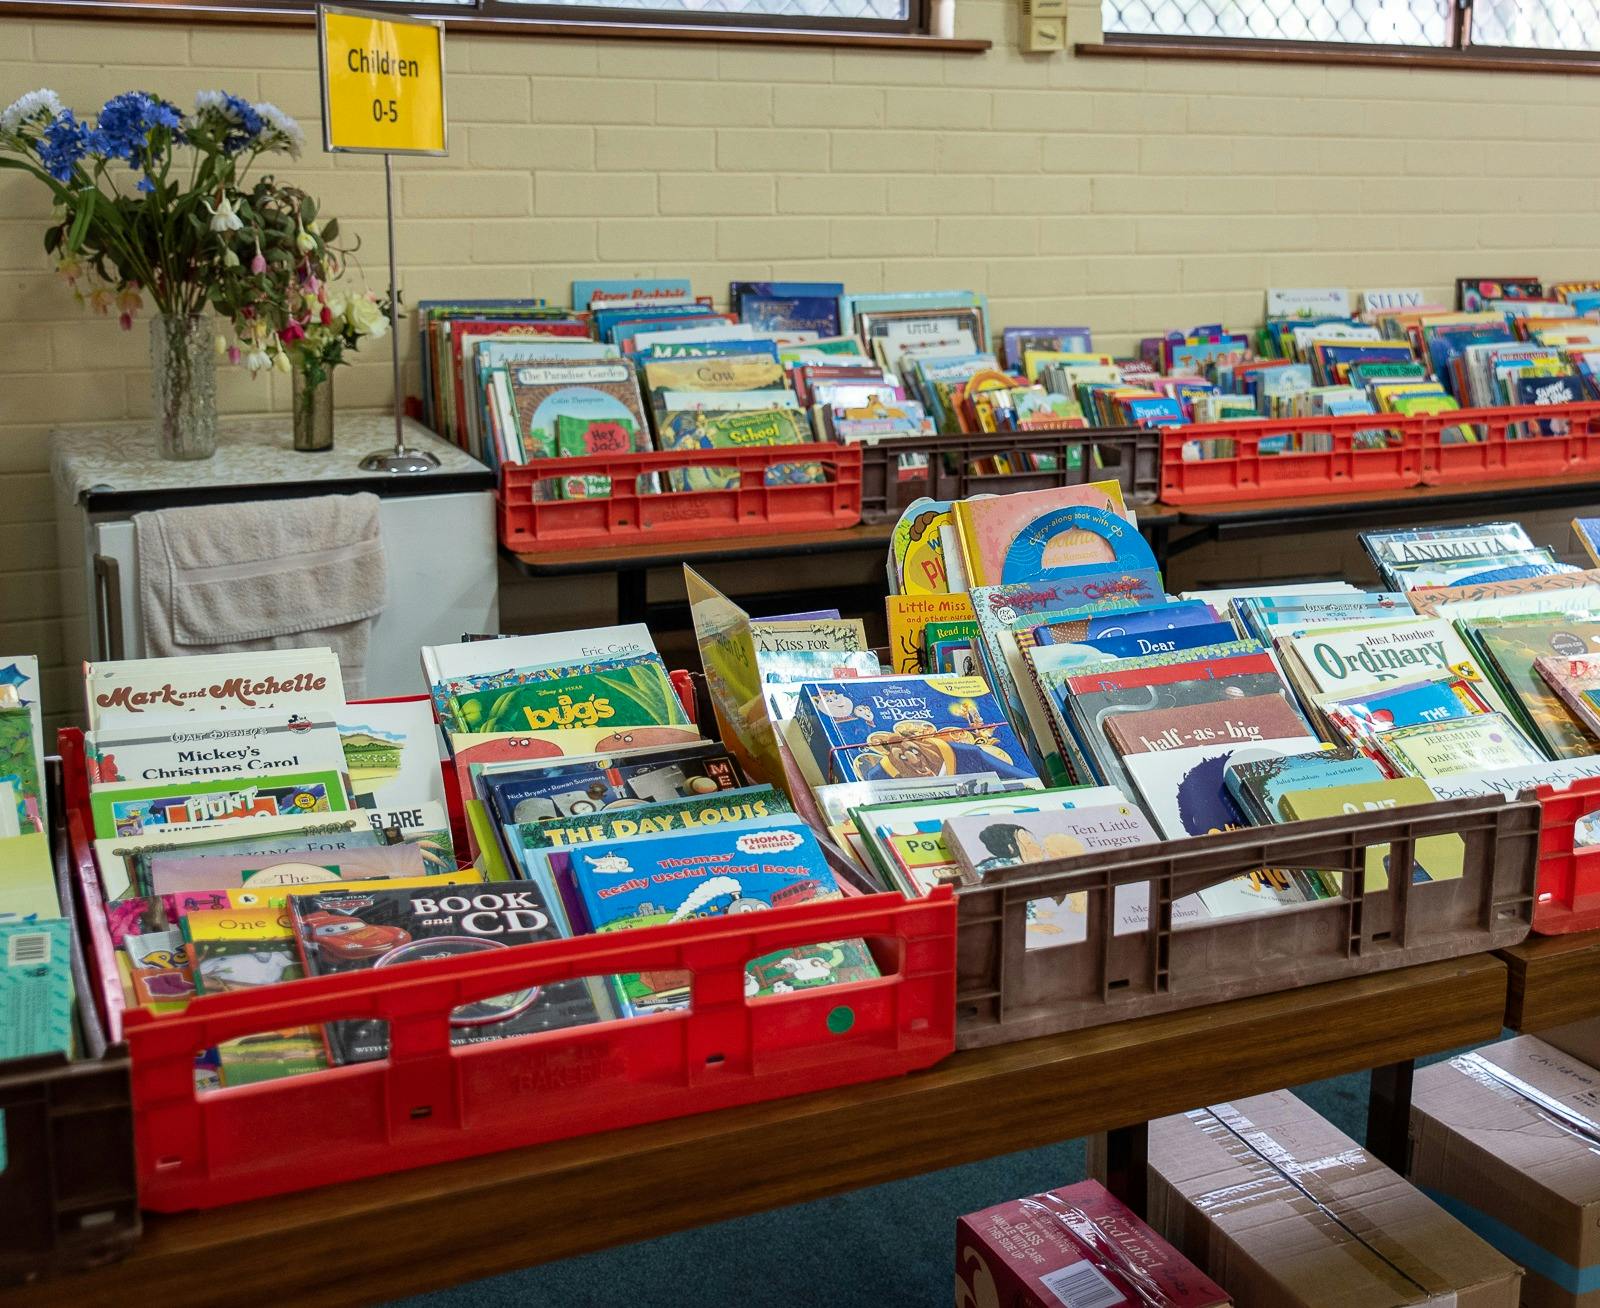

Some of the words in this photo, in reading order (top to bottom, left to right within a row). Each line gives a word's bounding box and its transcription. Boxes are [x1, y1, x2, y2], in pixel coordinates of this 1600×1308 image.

[347, 48, 419, 78] Children
[372, 98, 398, 123] 0-5
[1367, 292, 1420, 309] SILLY
[906, 322, 940, 335] LITTLE
[522, 370, 540, 382] The
[696, 366, 735, 382] Cow
[1134, 404, 1170, 418] Spot's
[591, 429, 617, 441] Hey
[729, 423, 782, 444] School
[1092, 515, 1110, 528] with
[1402, 538, 1508, 562] ANIMALIA
[898, 600, 935, 614] Little
[938, 601, 967, 612] Miss
[906, 615, 922, 624] and
[924, 614, 947, 623] other
[936, 625, 959, 639] Read
[962, 625, 970, 635] it
[1365, 634, 1388, 646] Just
[1391, 628, 1435, 643] Another
[581, 644, 603, 657] Eric
[607, 642, 641, 656] Carle
[759, 639, 772, 651] A
[1137, 638, 1176, 655] Dear
[1313, 640, 1449, 680] Ordinary
[96, 683, 186, 713] Mark
[178, 687, 208, 700] and
[208, 672, 327, 707] Michelle
[557, 694, 574, 706] a
[522, 692, 616, 730] bug's
[871, 695, 927, 710] Beauty
[889, 707, 935, 721] Beast
[1419, 705, 1452, 722] THE
[1423, 729, 1483, 747] JEREMIAH
[177, 745, 261, 764] Mickey's
[142, 760, 244, 781] Christmas
[246, 755, 300, 772] Carol
[1433, 763, 1454, 776] Janet
[506, 792, 523, 800] Nick
[524, 787, 547, 798] Bryant
[551, 781, 574, 791] Rowan
[573, 775, 606, 785] Summers
[878, 794, 897, 802] LEE
[898, 790, 951, 800] PRESSMAN
[184, 785, 259, 825] HUNT
[387, 808, 425, 829] ARE
[543, 823, 610, 847] THE
[611, 814, 675, 839] DAY
[679, 799, 771, 830] LOUIS
[1067, 823, 1098, 836] Ten
[1100, 817, 1140, 833] Little
[740, 832, 797, 846] THOMAS
[756, 840, 796, 850] FRIENDS
[1085, 833, 1141, 849] Fingers
[656, 852, 736, 870] Thomas'
[274, 873, 310, 885] The
[596, 877, 651, 900] Really
[651, 865, 708, 884] Useful
[709, 862, 760, 875] Word
[761, 863, 811, 877] Book
[409, 891, 540, 916] BOOK
[218, 918, 267, 931] One
[421, 915, 454, 927] and
[461, 908, 550, 935] CD
[353, 1045, 383, 1054] WITH
[1528, 1053, 1593, 1085] Children
[985, 1224, 1004, 1242] THIS
[1001, 1237, 1019, 1254] SIDE
[990, 1214, 1017, 1237] HANDLE
[1010, 1233, 1029, 1250] WITH
[1024, 1247, 1046, 1265] CARE
[1014, 1221, 1045, 1247] GLASS
[1094, 1214, 1130, 1238] Red
[1120, 1238, 1164, 1268] Label
